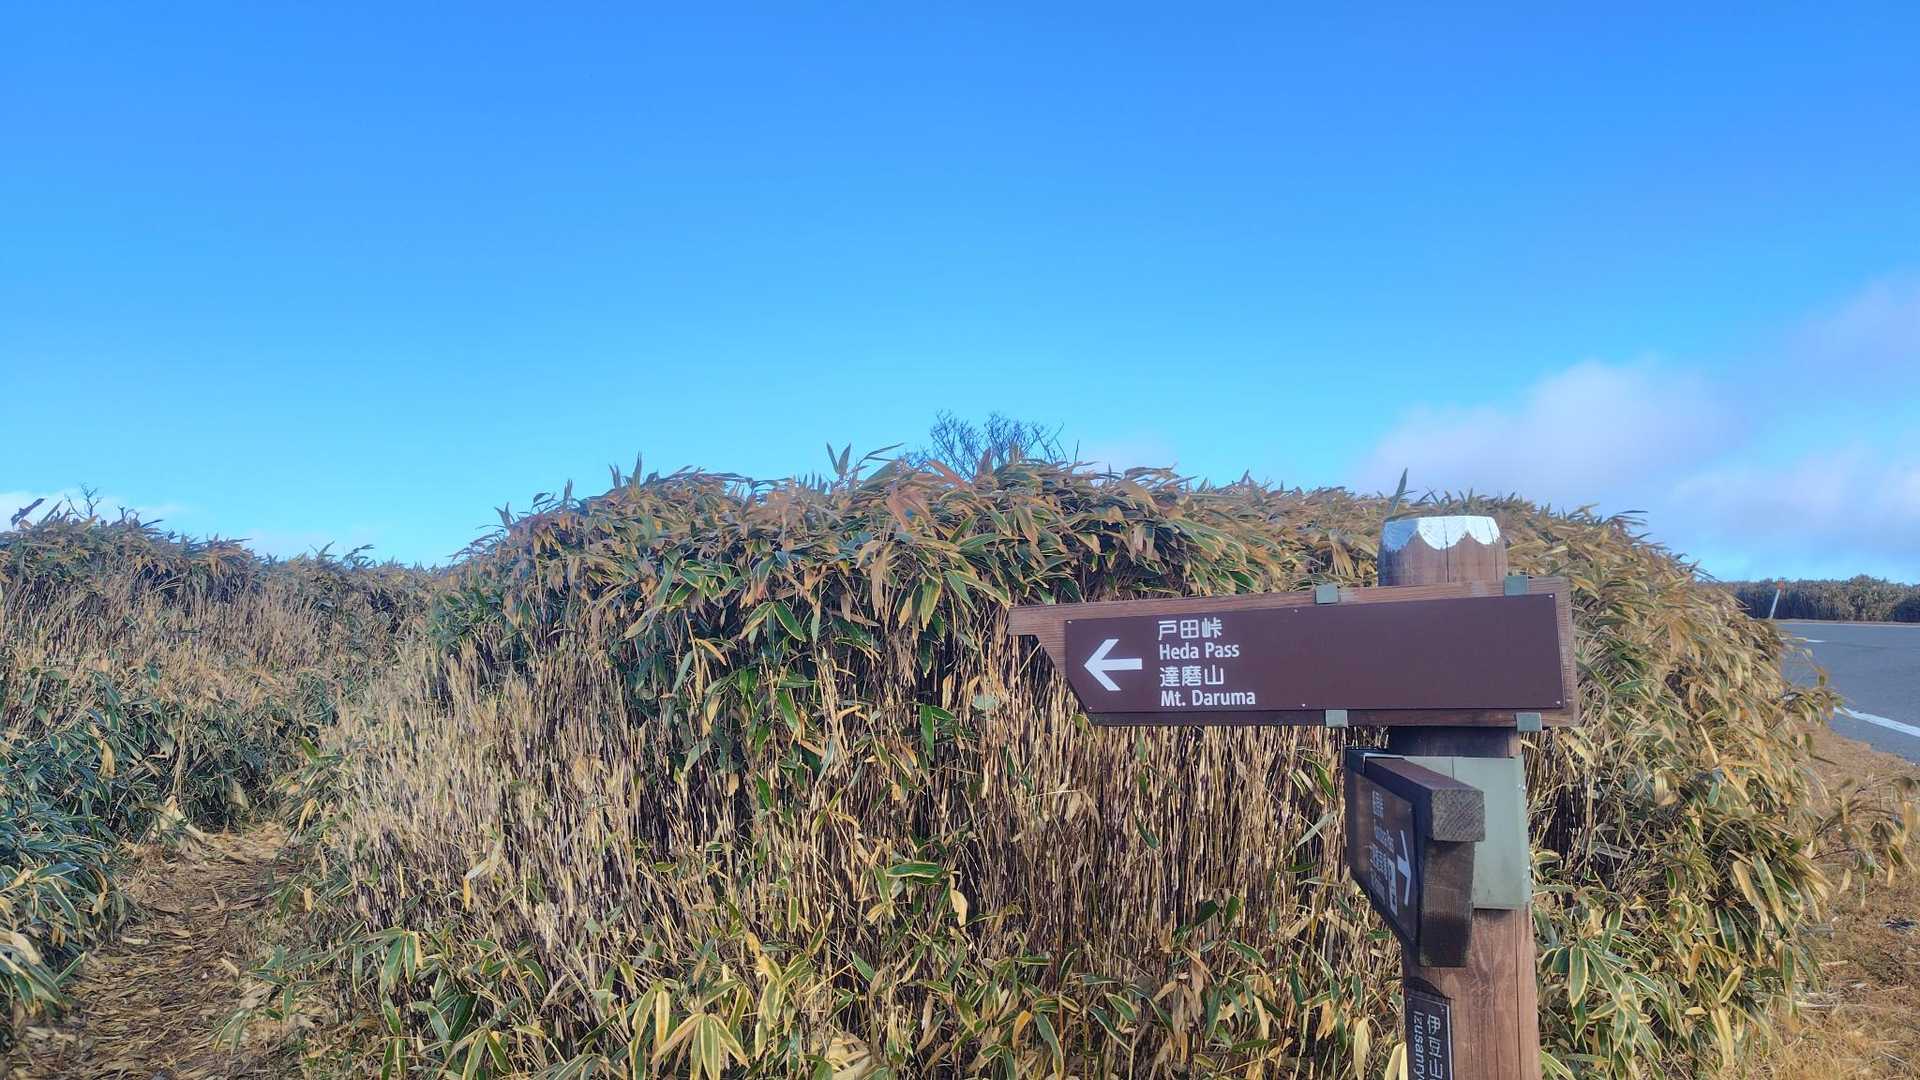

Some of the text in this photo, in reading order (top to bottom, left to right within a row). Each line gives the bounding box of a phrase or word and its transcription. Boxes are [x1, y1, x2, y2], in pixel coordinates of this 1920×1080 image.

[1158, 617, 1223, 640] 戸田峠
[1159, 642, 1240, 660] Heda Pass
[1160, 664, 1224, 687] 達磨山
[1161, 690, 1256, 706] Mt. Daruma
[1413, 1010, 1425, 1080] Izusanry
[1427, 1014, 1443, 1080] 伊豆山
